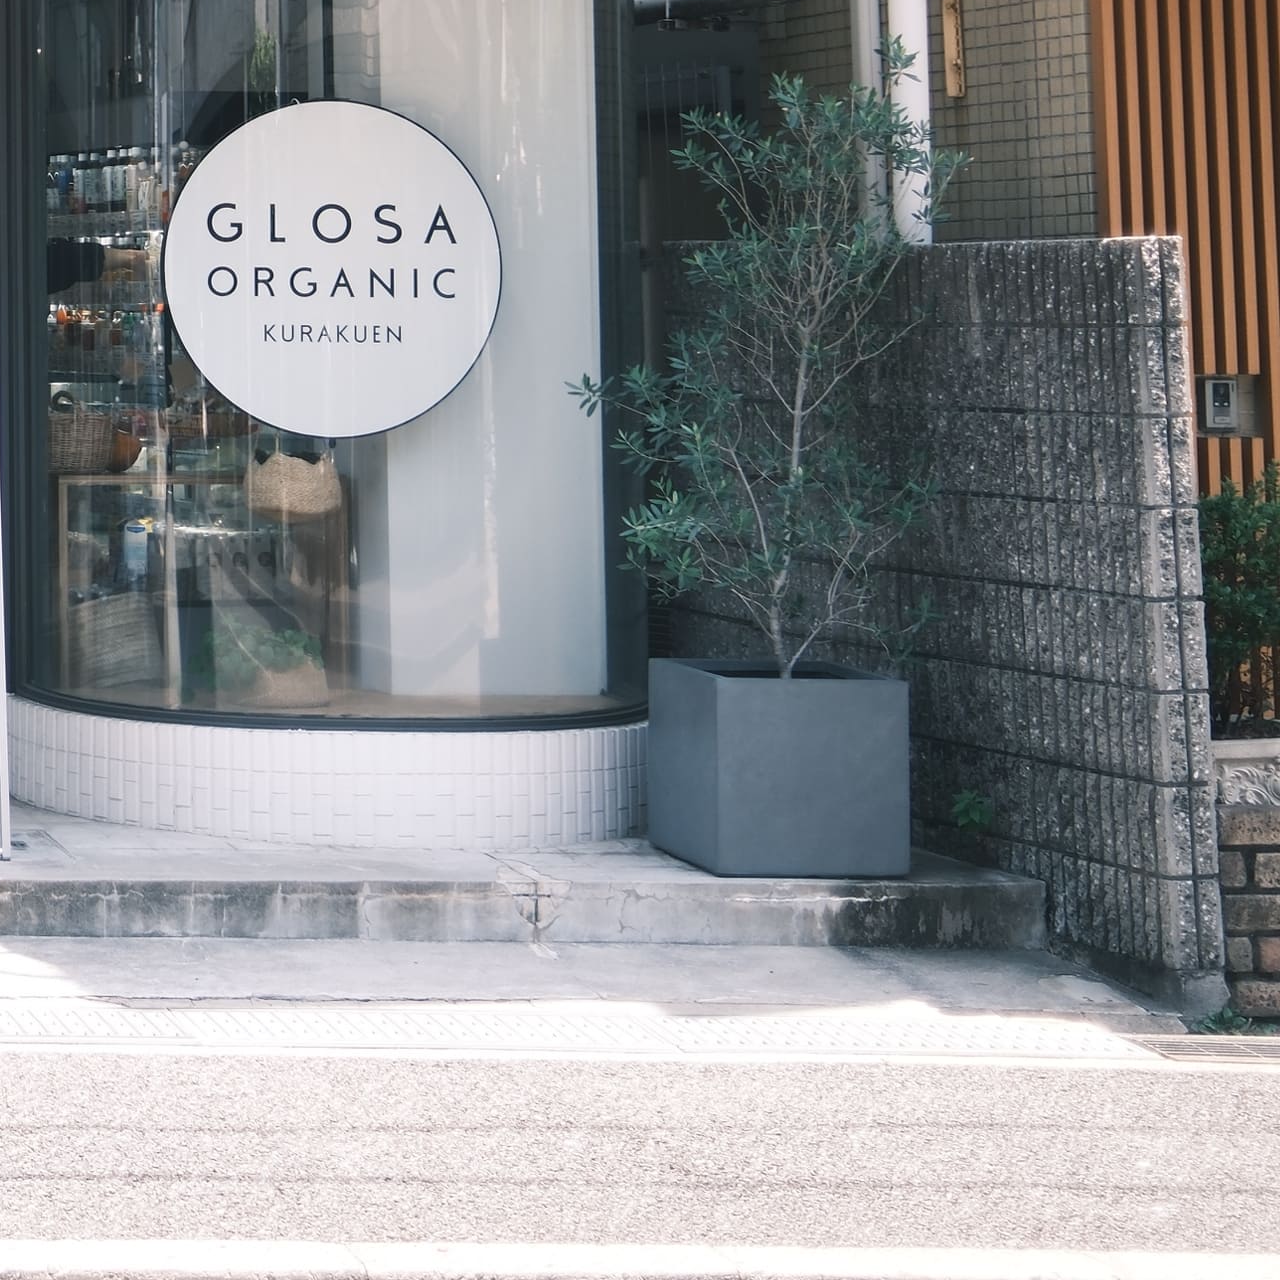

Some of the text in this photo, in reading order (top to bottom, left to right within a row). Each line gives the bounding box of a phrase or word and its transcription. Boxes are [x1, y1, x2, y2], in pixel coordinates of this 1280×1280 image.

[206, 202, 458, 245] GLOSA
[207, 266, 457, 299] ORGANIC
[263, 323, 403, 344] KURAKUEN
